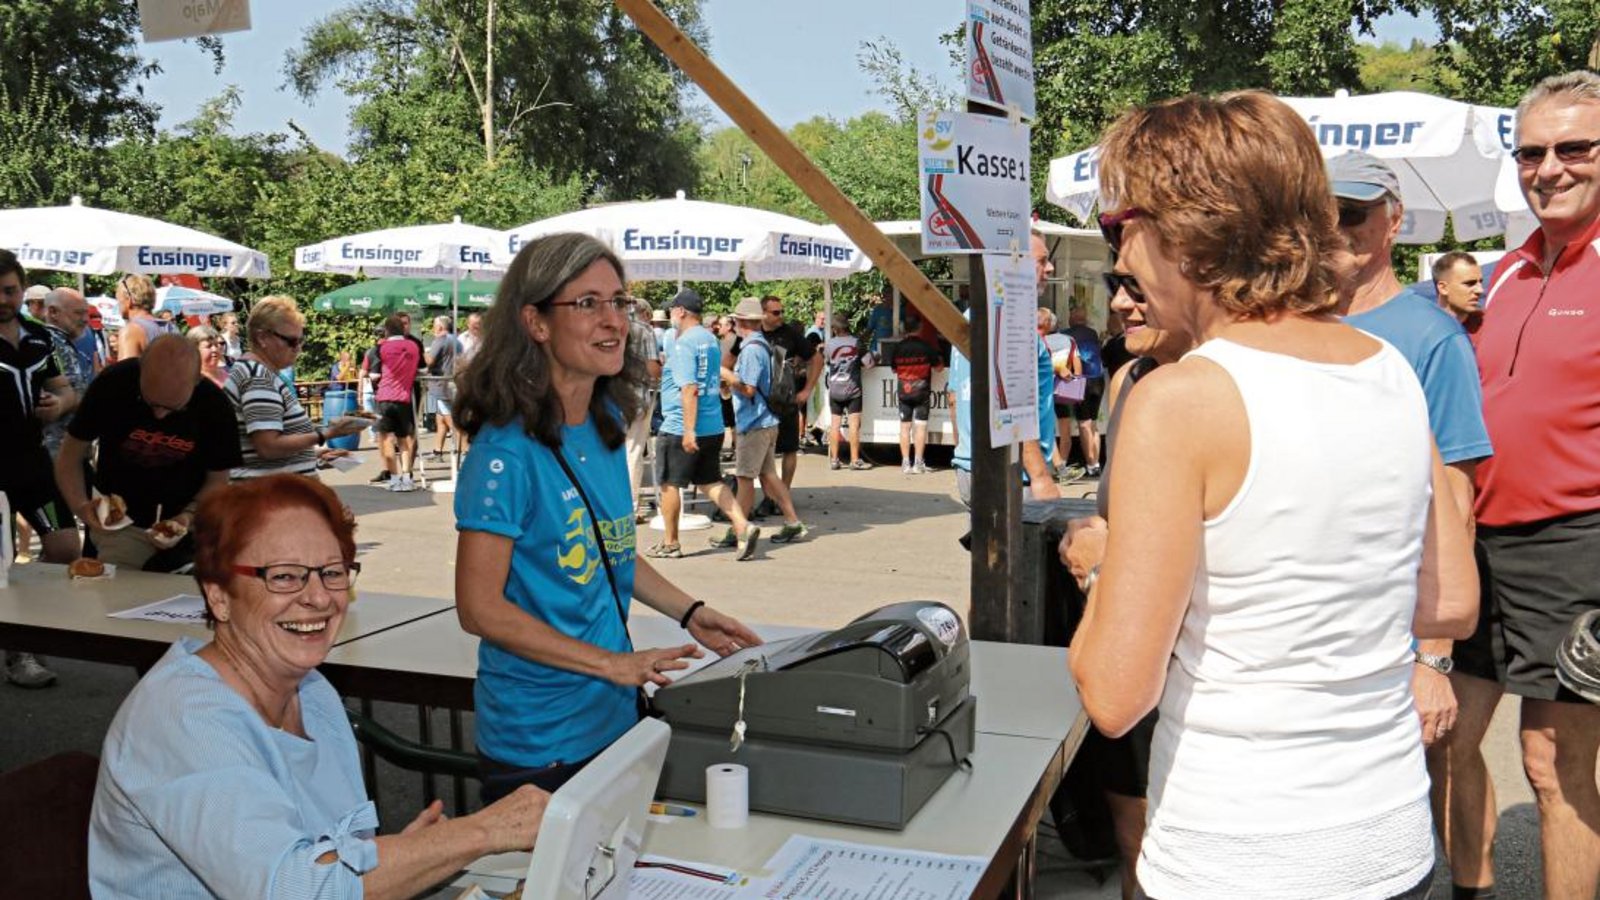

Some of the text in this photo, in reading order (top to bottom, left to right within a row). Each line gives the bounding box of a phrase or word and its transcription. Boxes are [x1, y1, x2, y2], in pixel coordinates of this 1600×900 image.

[957, 144, 1026, 181] Kasse 1
[341, 242, 423, 265] Ensinger
[624, 228, 743, 256] Ensinger
[780, 233, 853, 264] Ensinger
[138, 246, 232, 271] Ensinger
[130, 428, 195, 451] adidas
